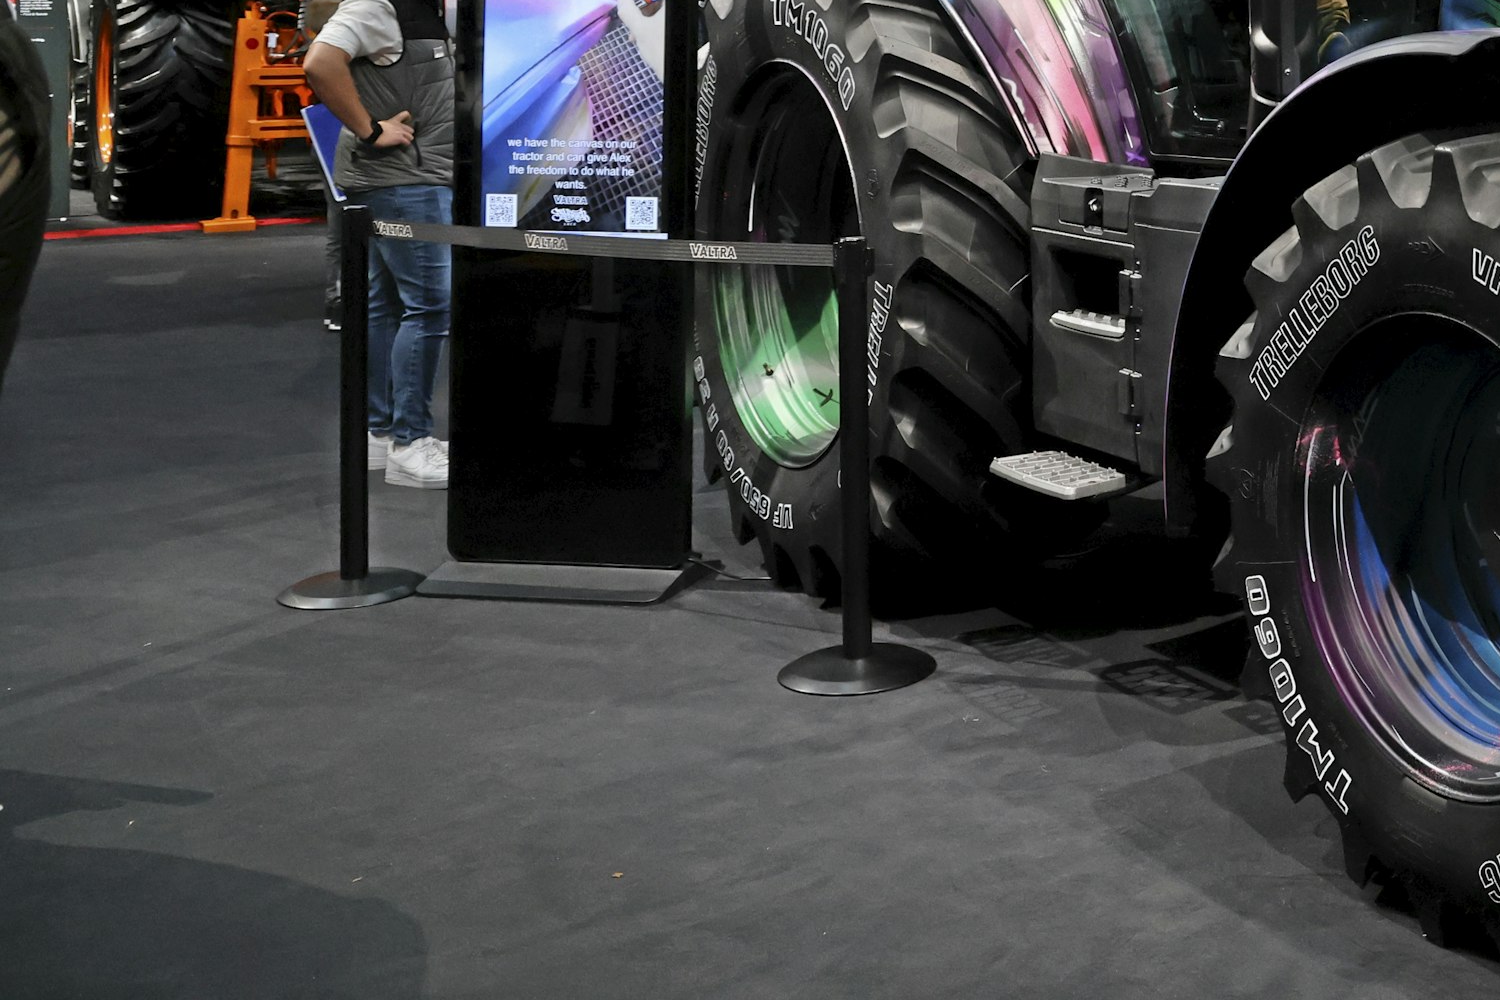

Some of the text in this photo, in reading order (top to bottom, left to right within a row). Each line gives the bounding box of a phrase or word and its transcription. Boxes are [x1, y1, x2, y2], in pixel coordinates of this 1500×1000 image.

[508, 138, 637, 149] we have the canvas on our
[512, 152, 631, 164] tractor and can give Alex
[509, 165, 635, 176] the freedom to do what he
[555, 180, 587, 189] wants.
[553, 194, 588, 205] VALTRA
[374, 220, 412, 237] VALTRA
[525, 234, 567, 251] VALTRA
[690, 243, 737, 260] VALTRA
[1248, 224, 1381, 401] TRELLEBORG
[706, 403, 720, 432] R
[772, 503, 794, 529] VF
[1245, 575, 1354, 815] TM1060
